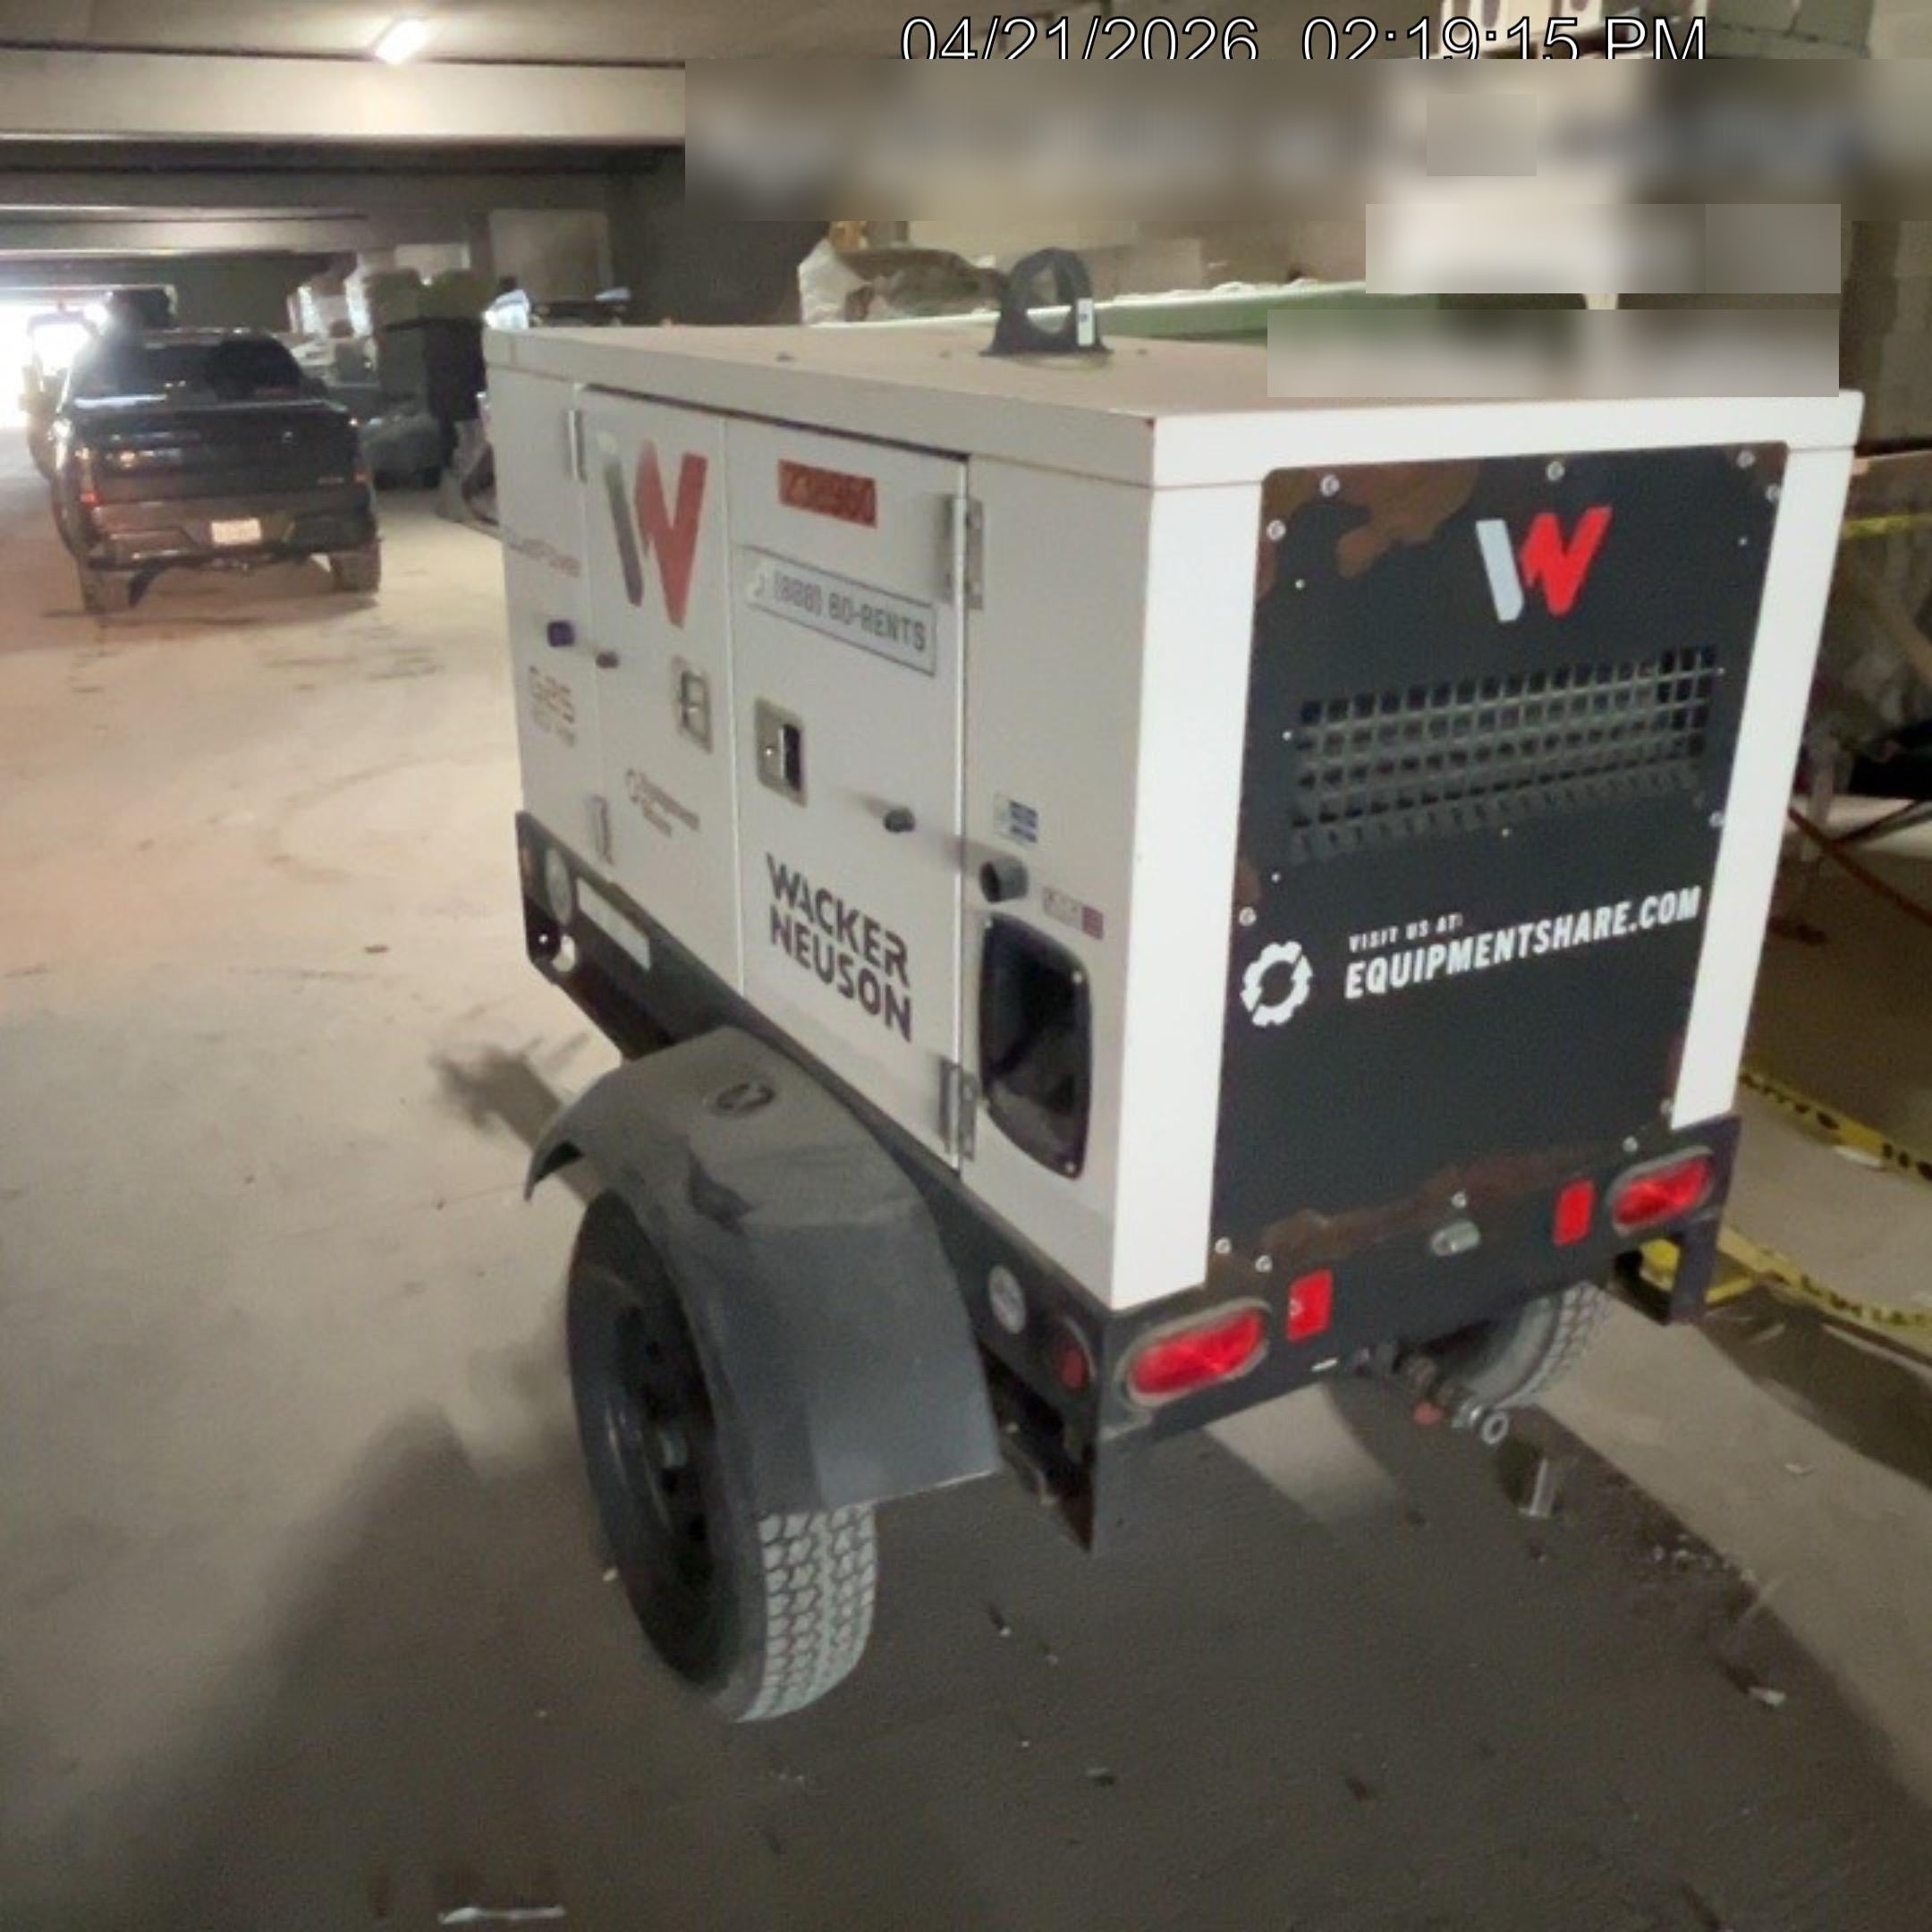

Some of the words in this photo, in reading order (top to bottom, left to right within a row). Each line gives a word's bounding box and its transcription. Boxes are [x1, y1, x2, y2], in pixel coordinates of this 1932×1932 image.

[766, 852, 911, 988] WACKER
[769, 903, 912, 1044] NEUSON
[1344, 886, 1702, 999] EQUIPMENTSHARE.COM
[1349, 924, 1399, 953] VISIT
[1405, 919, 1428, 940] US
